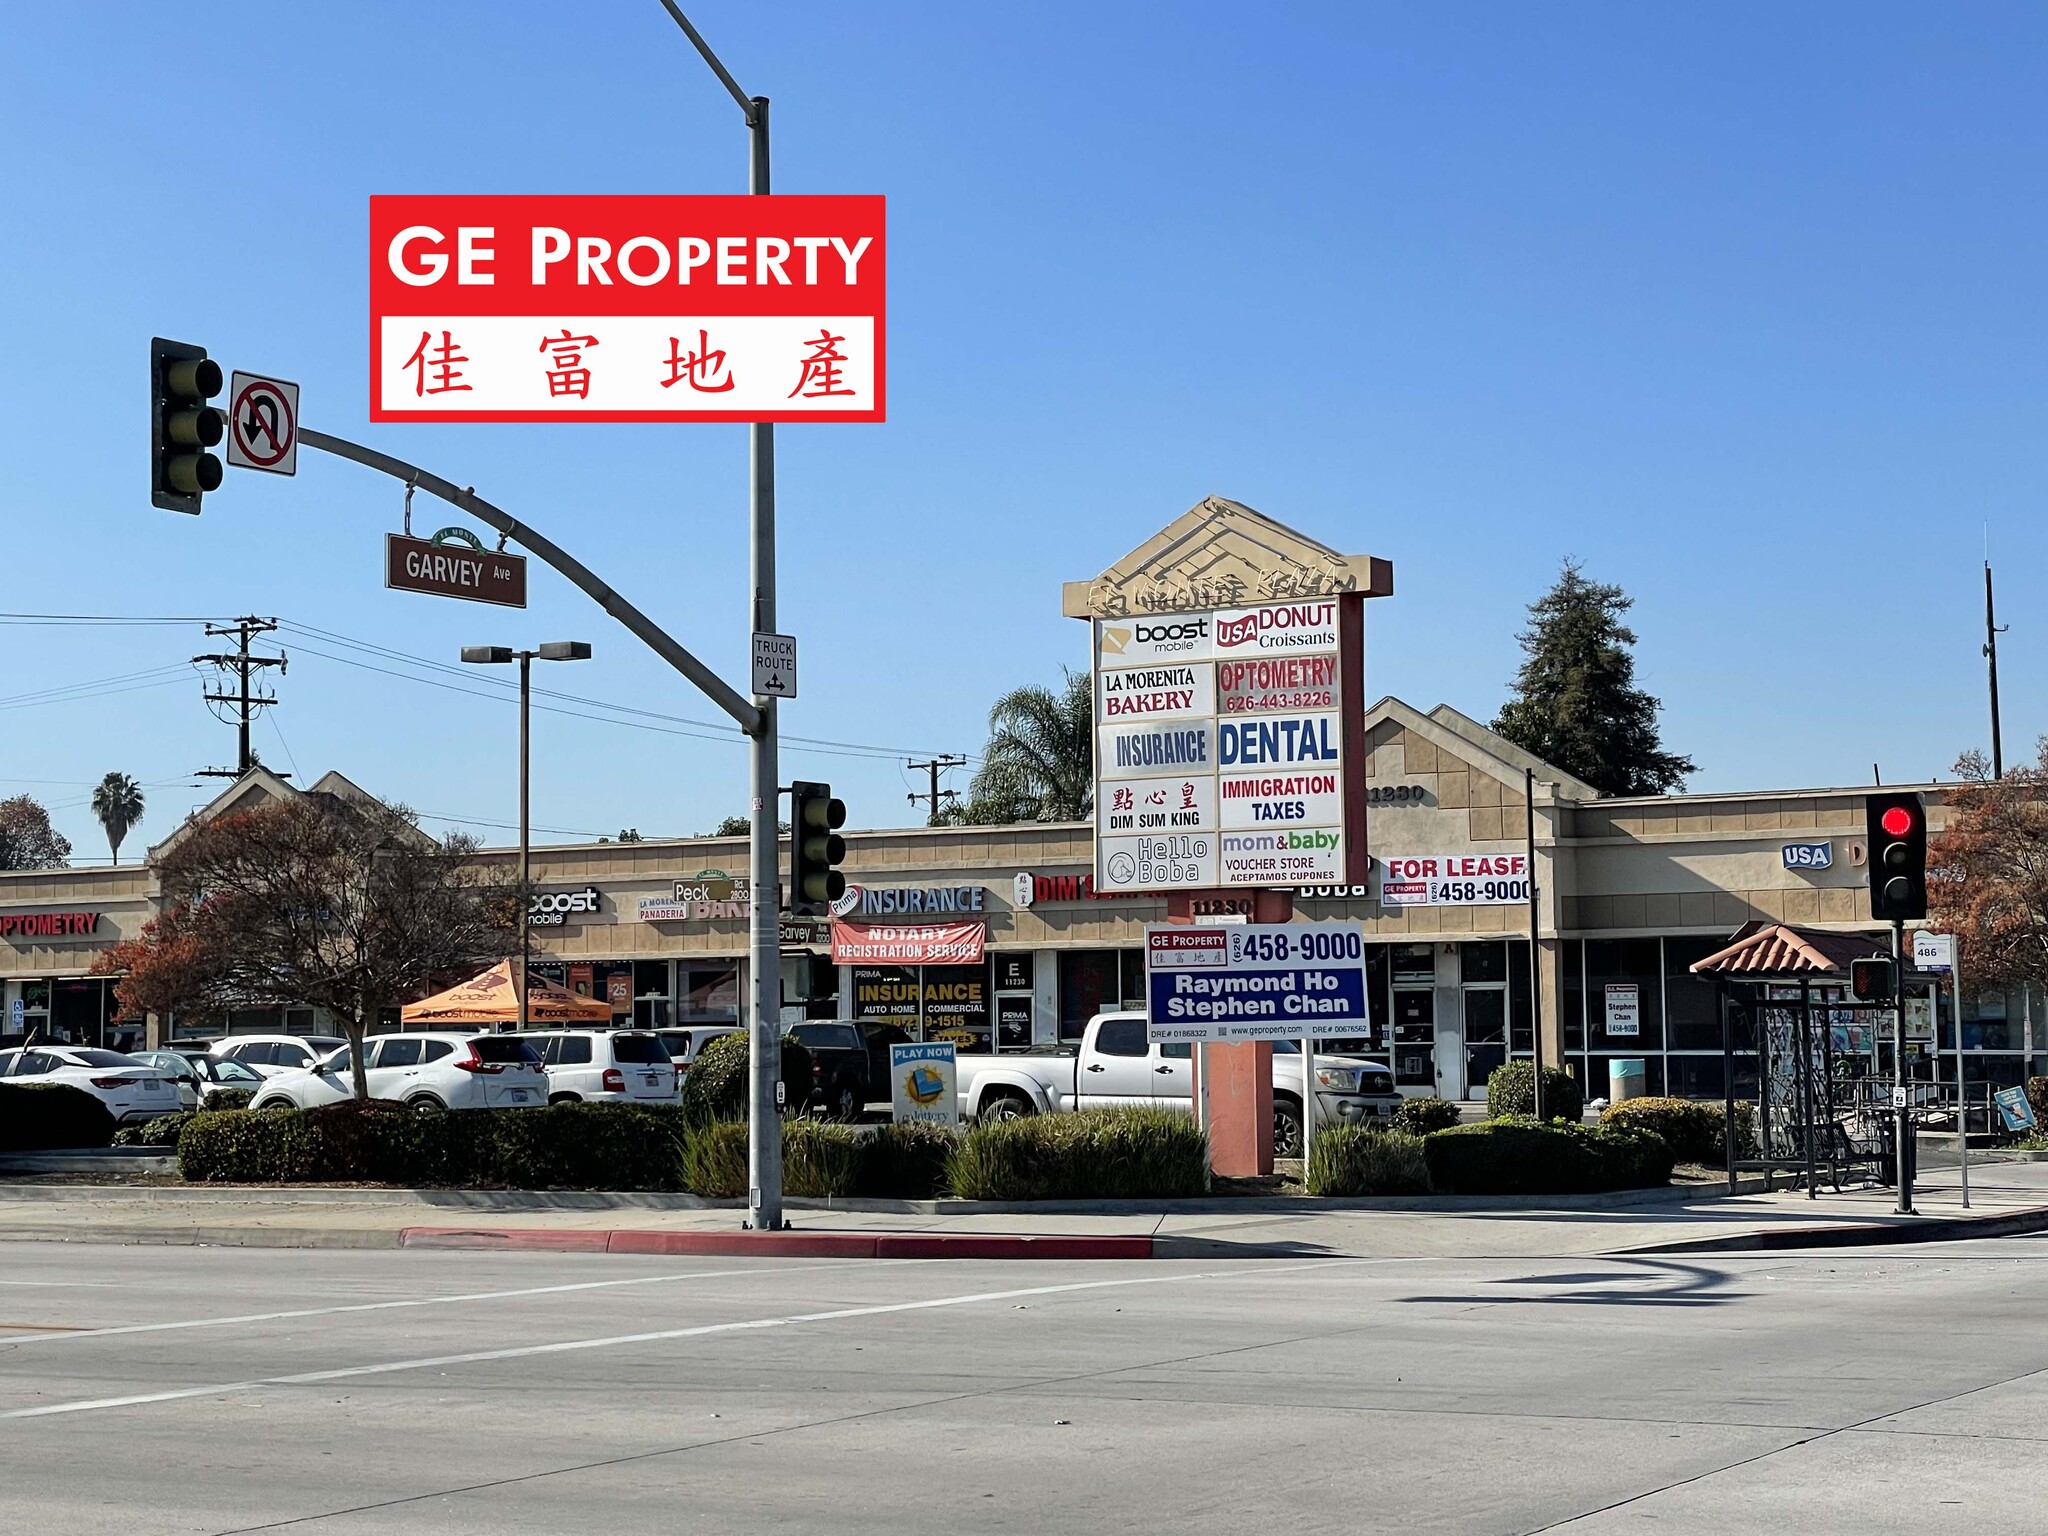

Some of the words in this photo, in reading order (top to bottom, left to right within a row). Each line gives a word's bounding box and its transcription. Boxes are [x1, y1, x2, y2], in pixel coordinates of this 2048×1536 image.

[406, 551, 483, 587] GARVEY
[493, 566, 511, 580] Ave
[1259, 604, 1336, 630] DONUT
[1135, 618, 1209, 643] boost
[1218, 619, 1257, 643] USA
[1259, 631, 1335, 648] Croissants
[756, 640, 793, 655] TRUCK
[1154, 641, 1194, 652] mobile
[756, 655, 793, 671] ROUTE
[1105, 674, 1123, 692] LA
[1125, 667, 1196, 690] MORENITA
[1220, 657, 1337, 692] OPTOMETRY
[1105, 689, 1194, 716] BAKERY
[1226, 691, 1331, 711] 626-443-8226
[1116, 730, 1206, 767] INSURANCE
[1220, 718, 1338, 765] DENTAL
[1112, 781, 1198, 811] 點心皇
[1222, 775, 1335, 798] IMMIGRATION
[1366, 785, 1424, 802] 1230
[1110, 815, 1134, 829] DIM
[1138, 813, 1166, 828] SUM
[1171, 811, 1200, 826] KING
[1252, 801, 1306, 820] TAXES
[1138, 836, 1207, 860] Hello
[1785, 847, 1828, 866] USA
[1138, 859, 1199, 884] Boba
[1225, 859, 1276, 870] VOUCHER
[1280, 857, 1314, 869] STORE
[1389, 860, 1438, 879] FOR
[1447, 856, 1526, 877] LEASE
[1230, 872, 1287, 882] ACEPTAMOS
[1290, 871, 1335, 880] CUPONES
[676, 884, 709, 900] Peck
[1035, 875, 1079, 902] DIM
[1396, 884, 1426, 892] PROPERTY
[640, 899, 647, 908] LA
[832, 889, 858, 913] Prima
[862, 886, 983, 914] INSURANCE
[640, 909, 685, 920] PANADERIA
[0, 913, 98, 936] PTOMETRY
[779, 923, 811, 943] Garvey
[868, 928, 947, 941] NOTARY
[1151, 935, 1169, 947] GE
[1172, 936, 1225, 946] PROPERTY
[838, 944, 922, 958] REGISTRATION
[927, 943, 978, 958] SERVICE
[1231, 933, 1243, 962] (626)
[1243, 932, 1361, 961] 458-9000
[1918, 948, 1937, 957] 486
[855, 970, 881, 979] PRIMA
[1009, 963, 1020, 977] E
[1005, 978, 1026, 986] 11230
[1175, 972, 1295, 997] Raymond
[1304, 971, 1339, 991] Ho
[858, 984, 982, 1001] INSURANCE
[864, 1005, 887, 1014] AUTO
[891, 1005, 916, 1013] HOME
[927, 1004, 985, 1013] COMMERCIAL
[1168, 996, 1276, 1019] Stephen
[1283, 995, 1349, 1013] Chan
[1608, 1003, 1637, 1011] Stephen
[1151, 1030, 1172, 1038] DRE#
[1231, 1026, 1303, 1036] www.geproperty.com
[895, 1049, 923, 1059] PLAY
[927, 1047, 952, 1057] NOW
